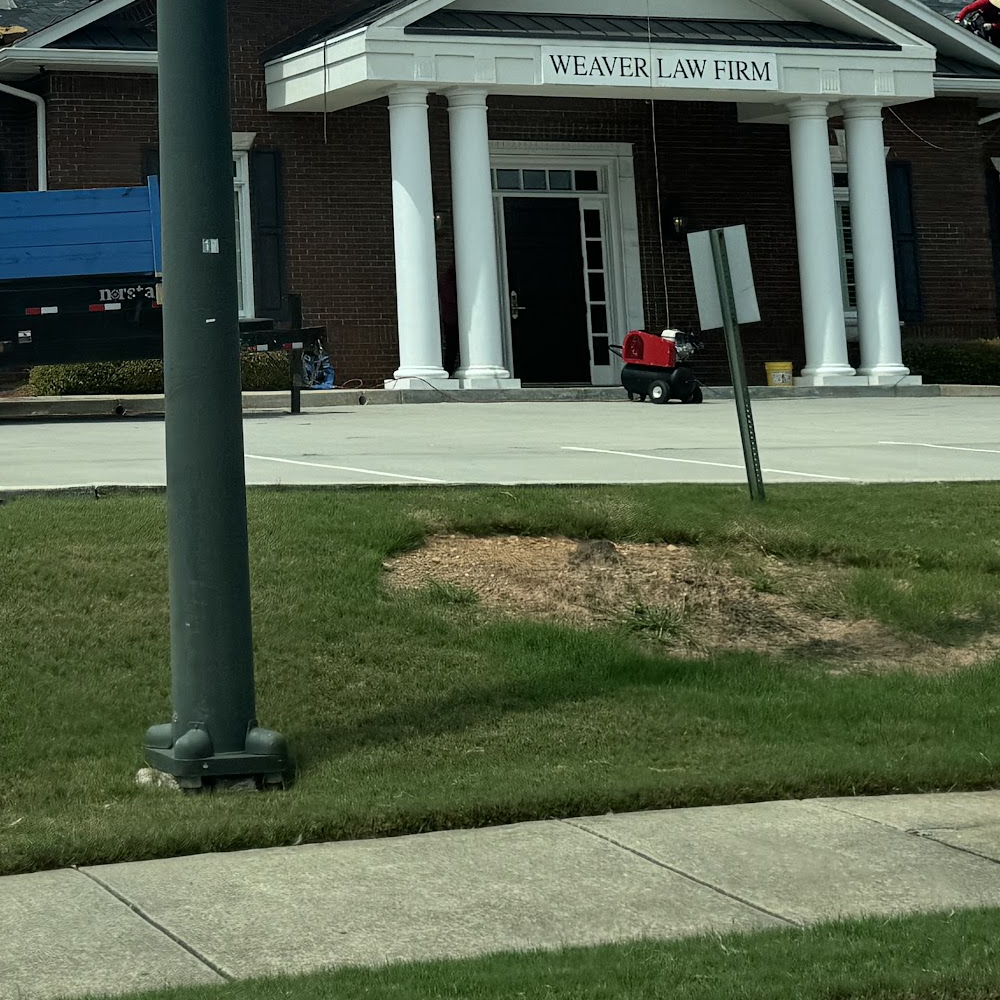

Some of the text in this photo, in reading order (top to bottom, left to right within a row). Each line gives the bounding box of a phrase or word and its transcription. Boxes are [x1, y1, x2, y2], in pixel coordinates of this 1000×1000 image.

[549, 54, 772, 82] WEAVER LAW FIRM
